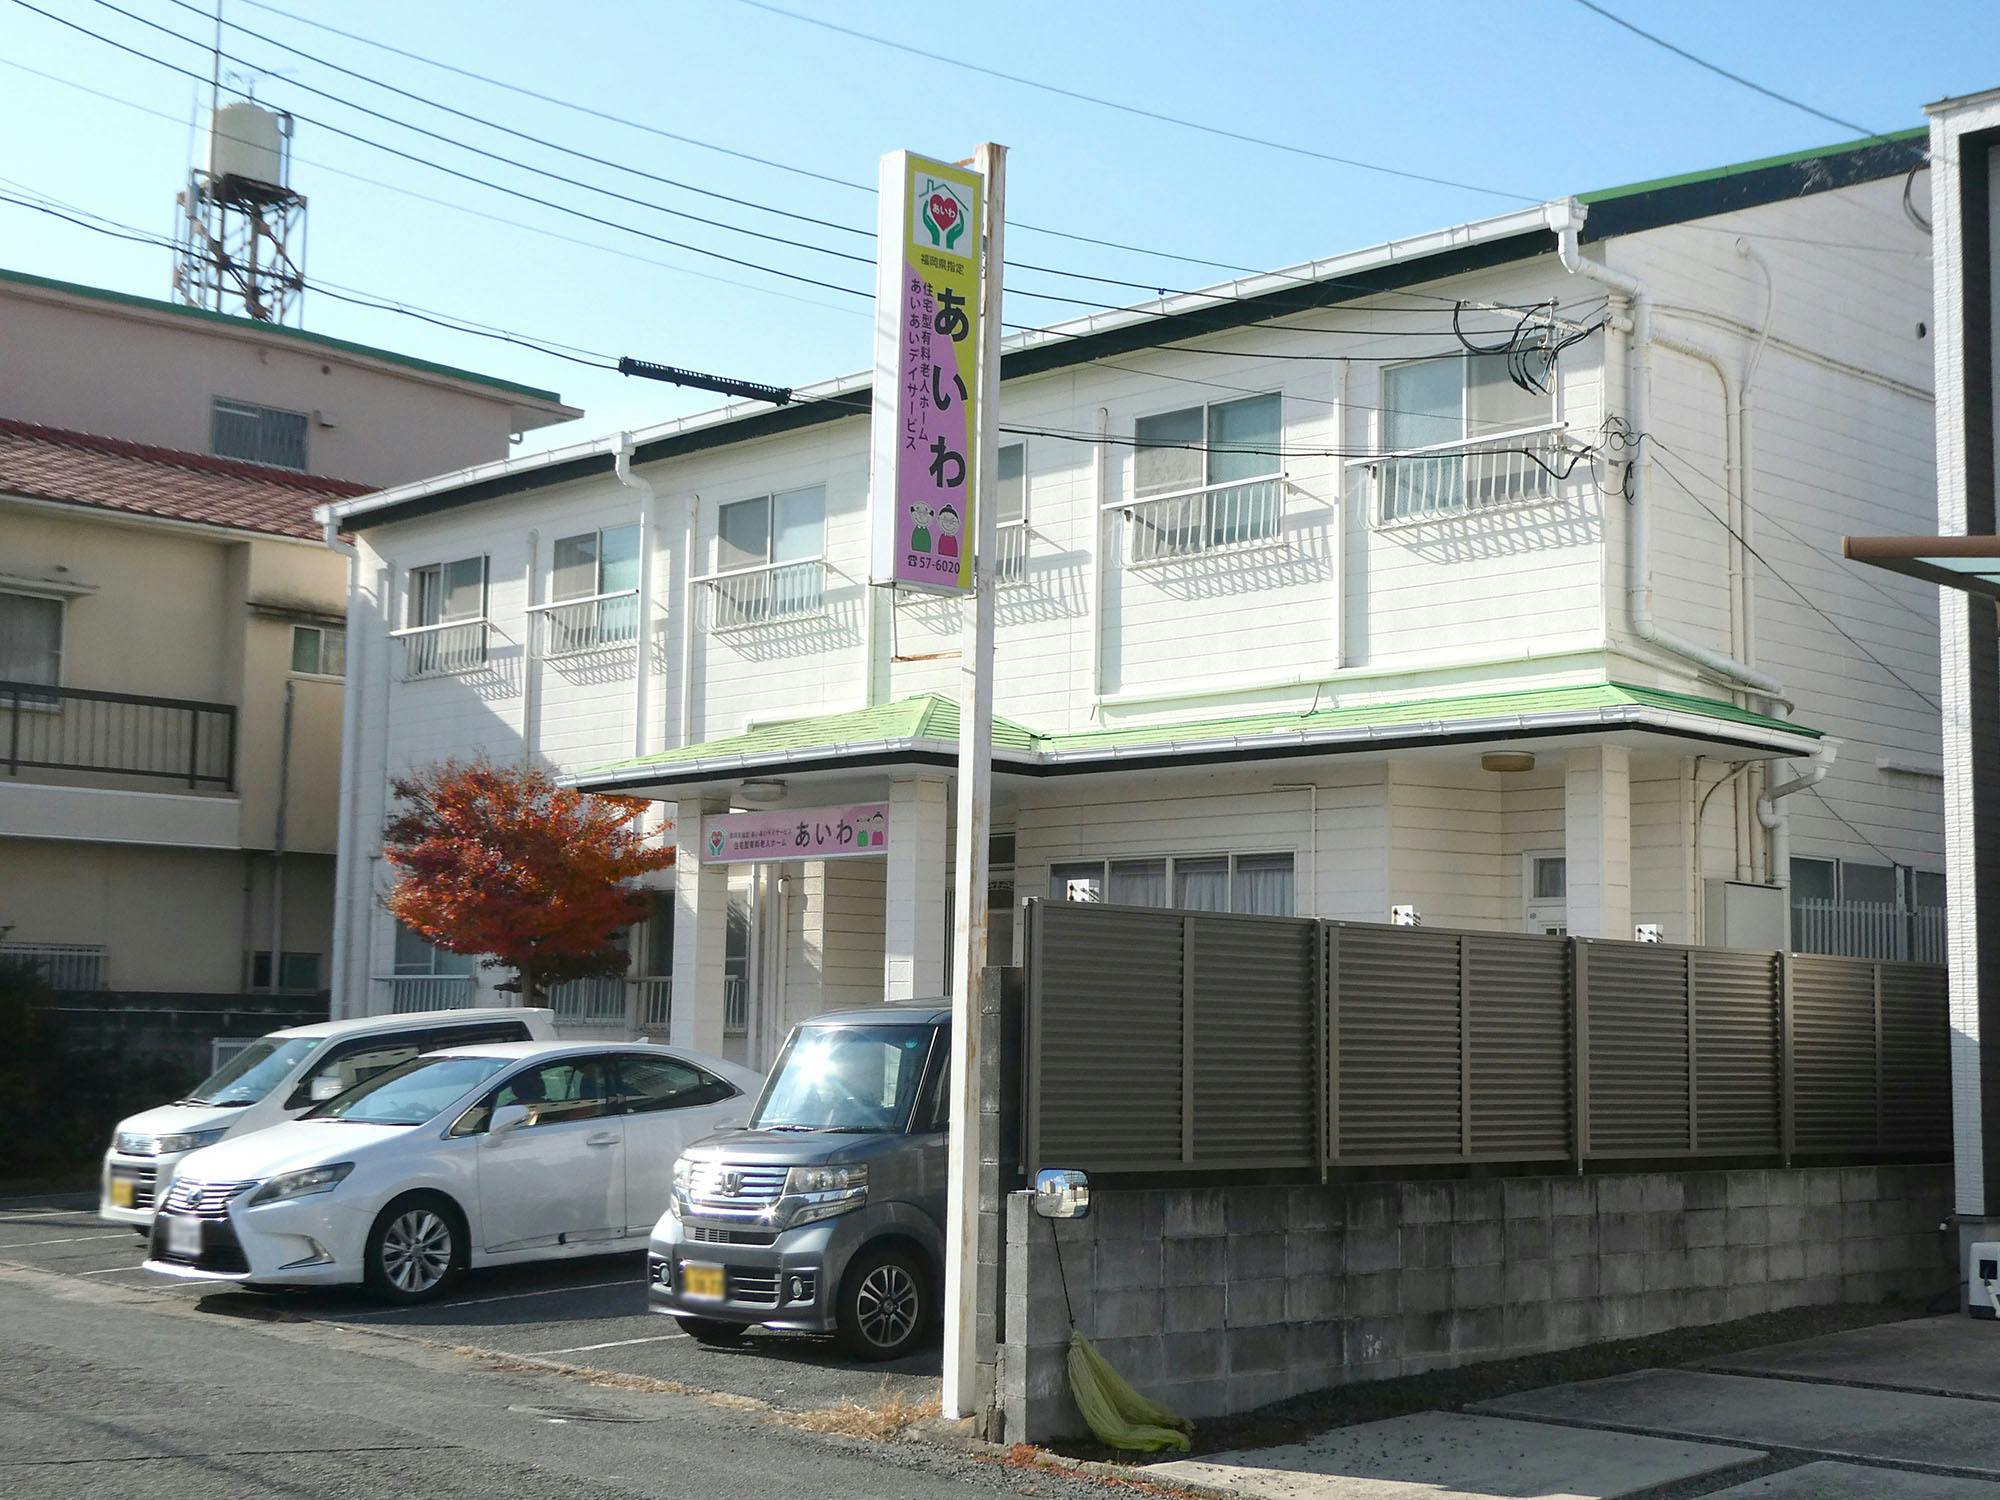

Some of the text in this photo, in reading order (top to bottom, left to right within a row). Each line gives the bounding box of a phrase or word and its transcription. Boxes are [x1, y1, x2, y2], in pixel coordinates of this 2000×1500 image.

[932, 203, 956, 218] あいわ
[920, 253, 965, 275] 福岡県指定
[918, 281, 934, 442] 住宅型有料老人ホーム
[929, 287, 970, 489] あいわ
[795, 818, 854, 848] あいわ
